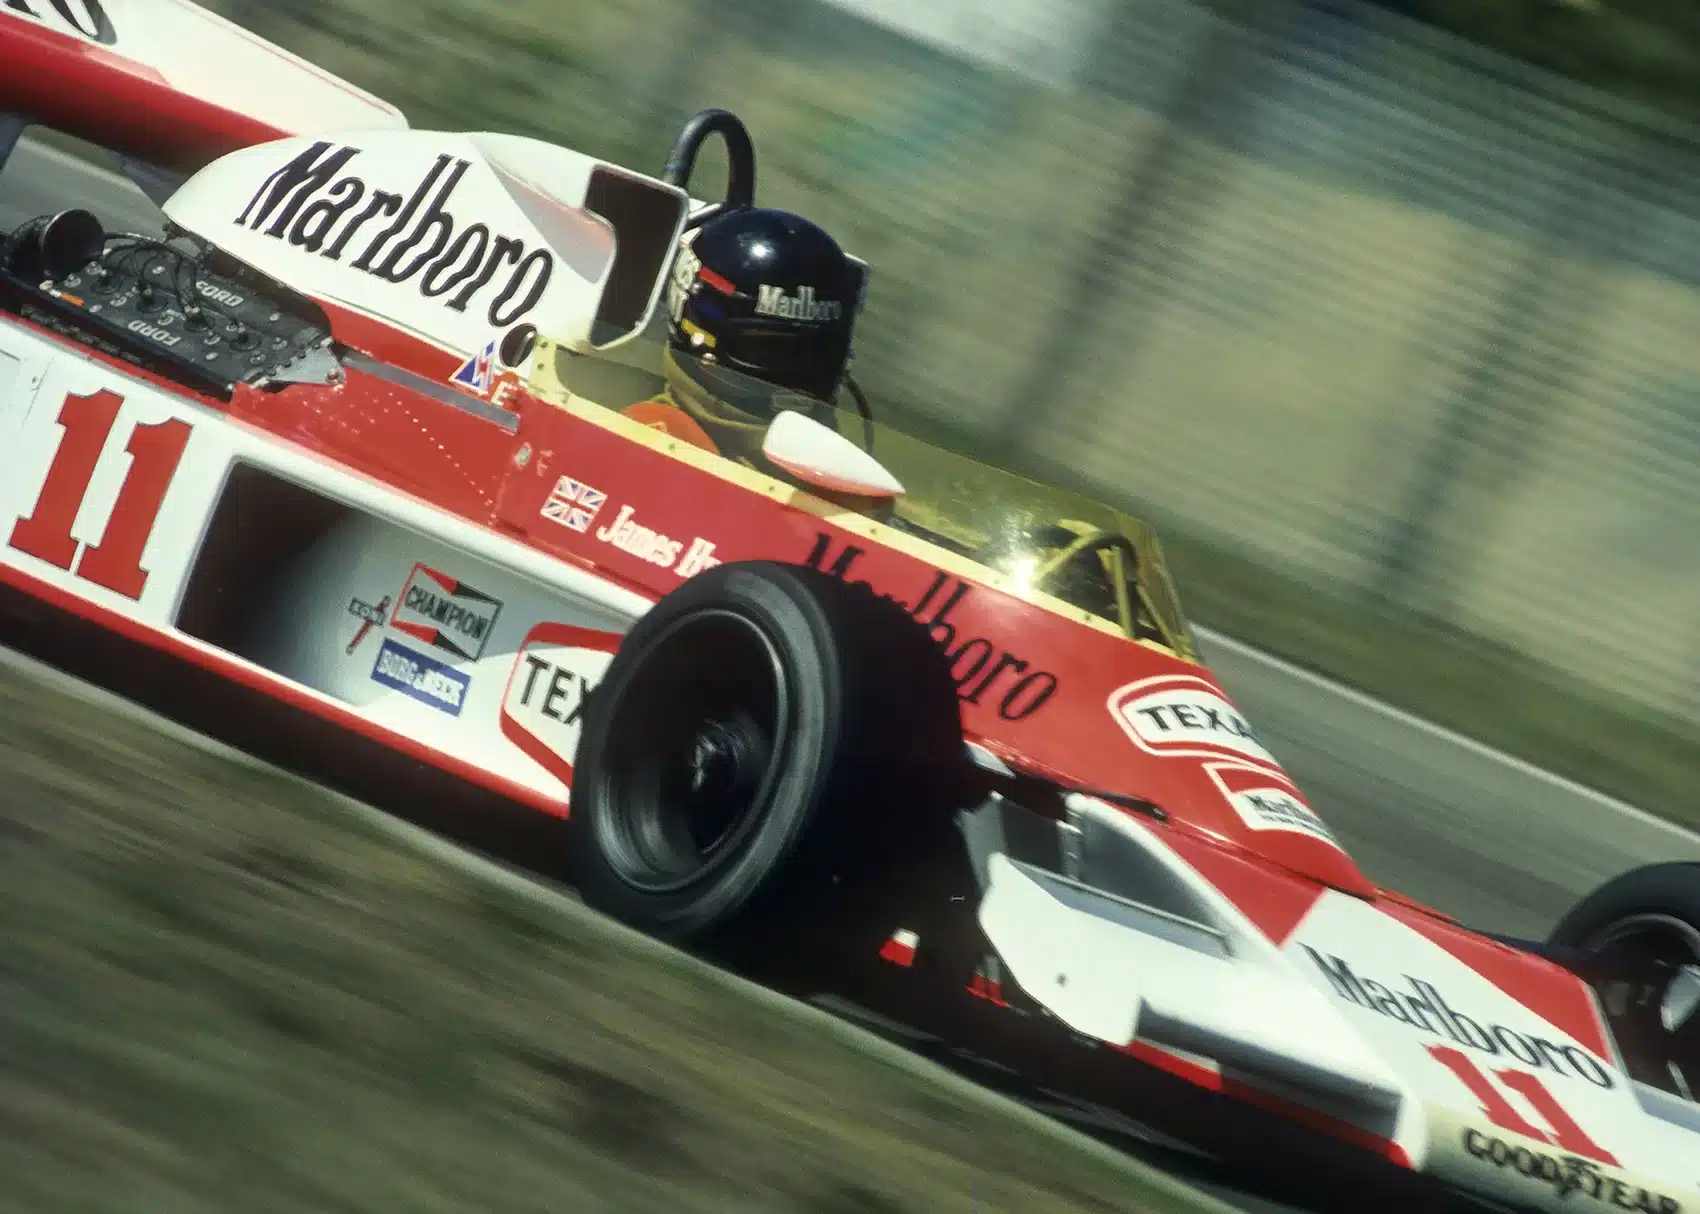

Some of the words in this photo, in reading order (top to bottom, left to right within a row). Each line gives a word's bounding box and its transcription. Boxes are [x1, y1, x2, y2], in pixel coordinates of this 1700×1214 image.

[233, 141, 554, 328] Marlboro
[127, 319, 181, 347] FORD
[754, 283, 842, 321] Marlboro
[7, 387, 195, 602] 11
[595, 503, 684, 568] James
[404, 585, 489, 640] CHAMPION
[1296, 940, 1614, 1090] Marlboro
[1420, 1041, 1624, 1170] 11
